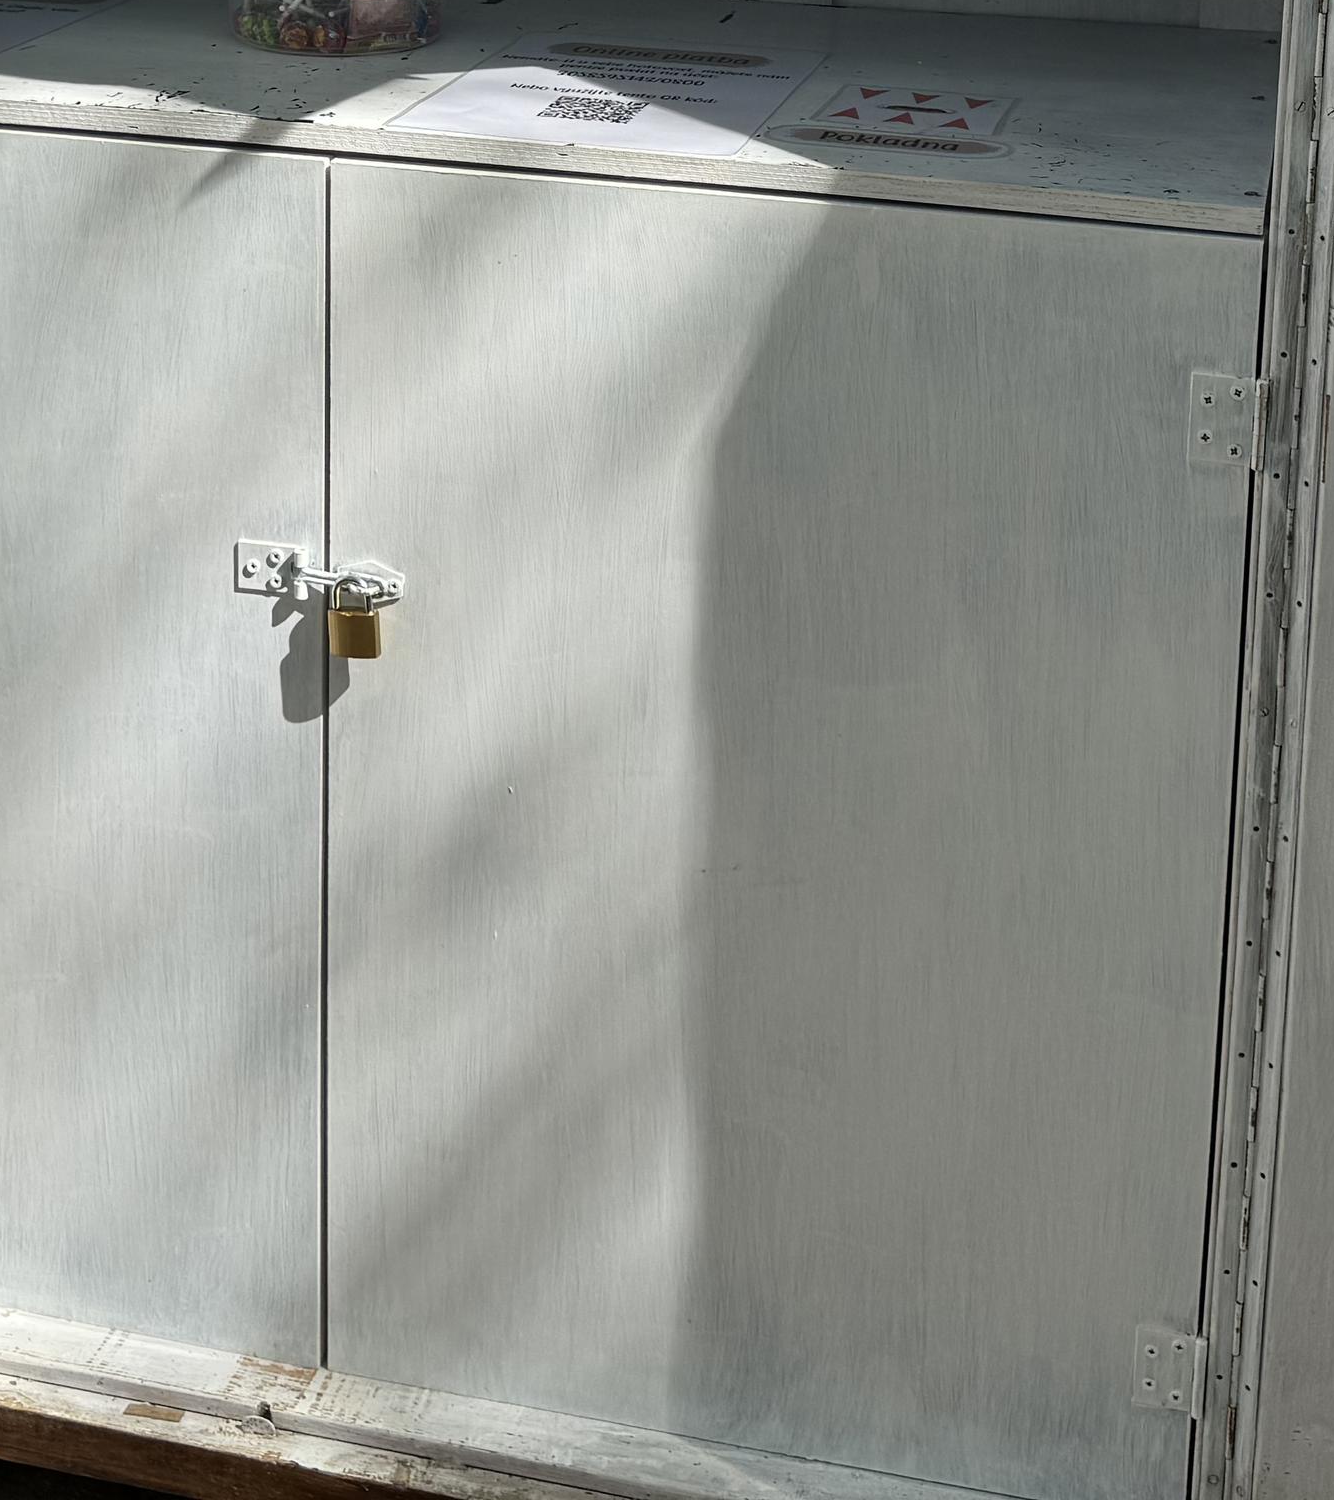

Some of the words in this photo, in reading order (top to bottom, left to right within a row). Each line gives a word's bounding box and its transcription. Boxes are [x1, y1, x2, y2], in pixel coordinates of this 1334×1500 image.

[573, 45, 656, 58] Online
[662, 53, 750, 66] platba
[510, 83, 549, 91] Nebo
[616, 91, 656, 99] tento
[819, 130, 960, 152] Pokladna
